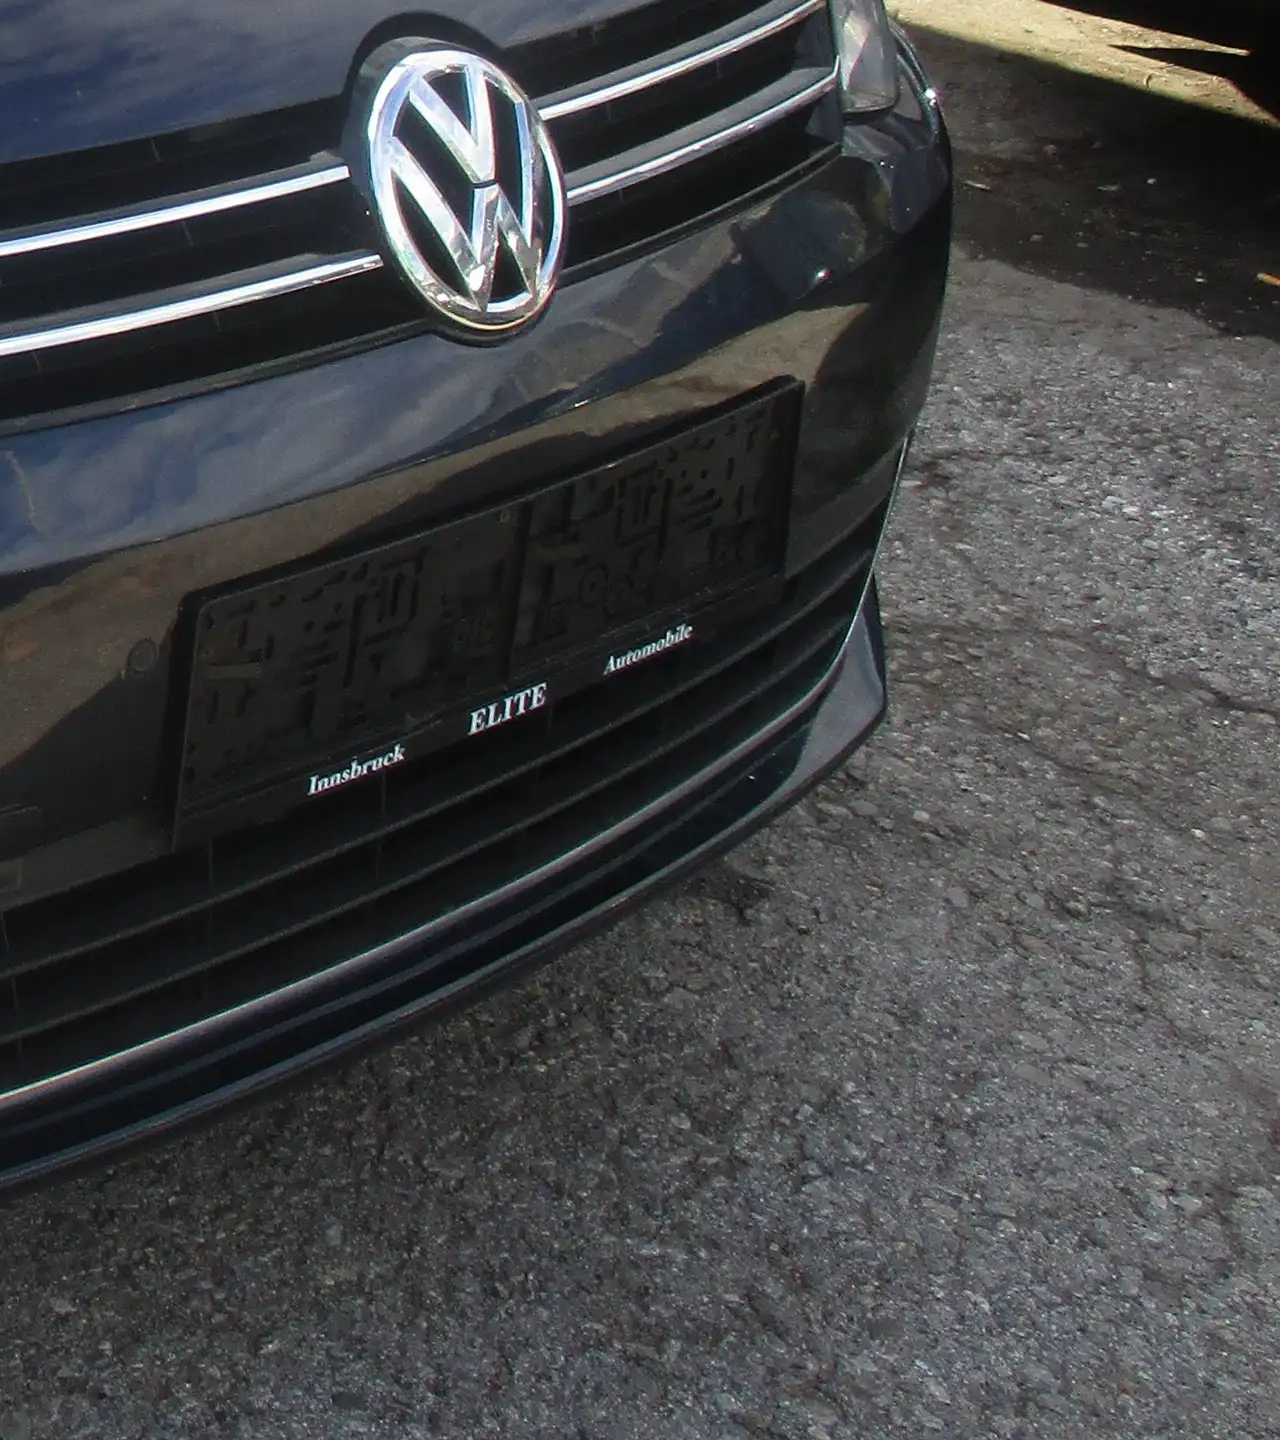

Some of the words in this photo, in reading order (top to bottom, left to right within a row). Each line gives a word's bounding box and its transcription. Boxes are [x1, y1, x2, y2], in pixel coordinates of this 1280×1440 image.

[307, 742, 407, 797] Innsbruck
[467, 681, 548, 736] ELITE
[602, 622, 694, 676] Automobile
